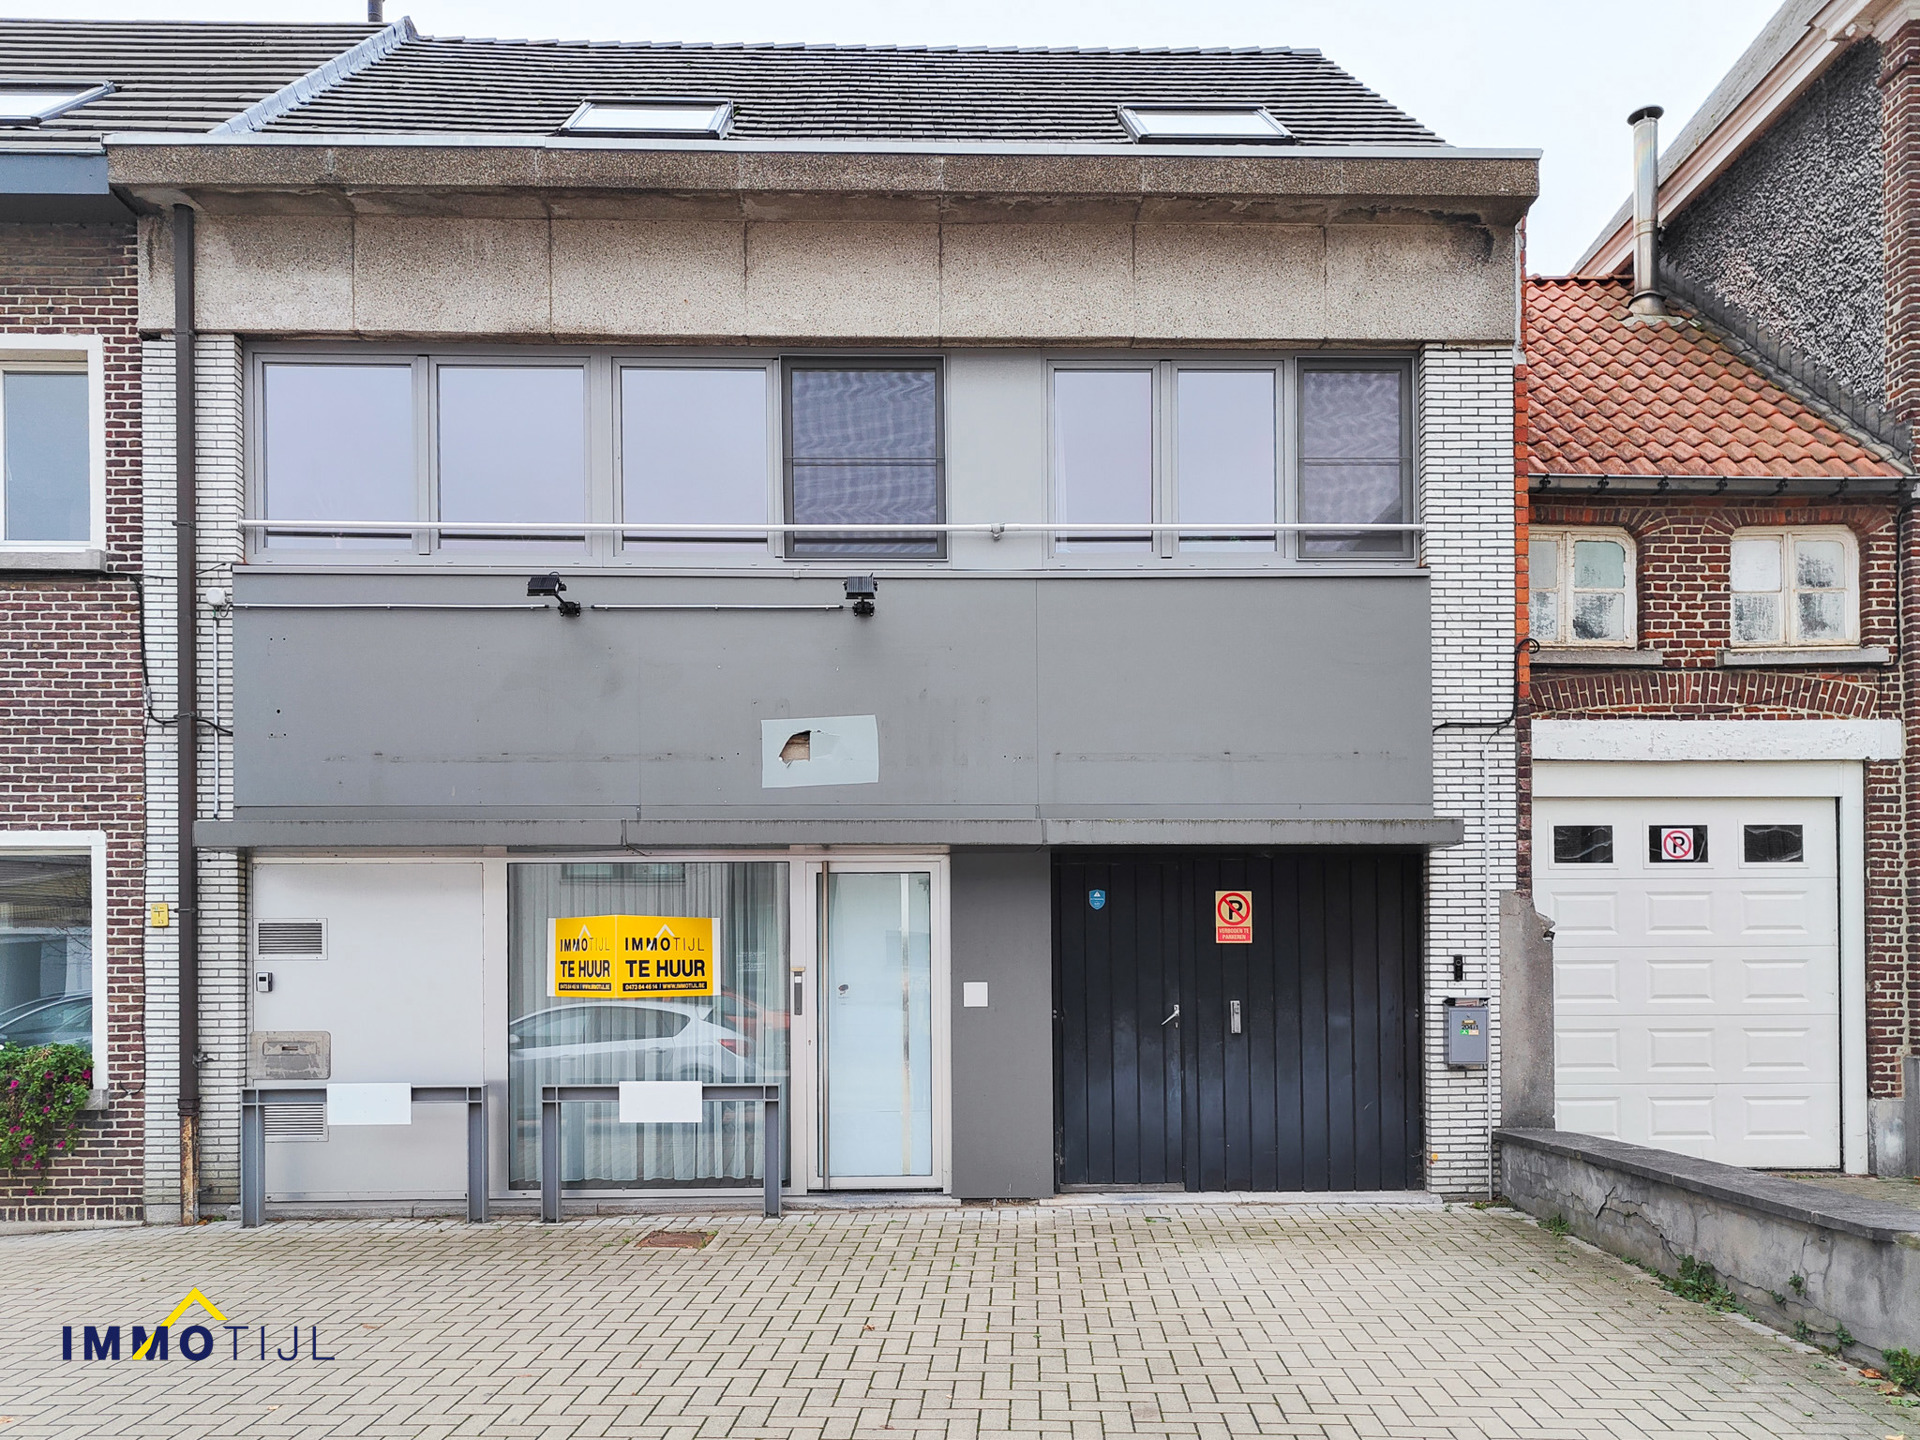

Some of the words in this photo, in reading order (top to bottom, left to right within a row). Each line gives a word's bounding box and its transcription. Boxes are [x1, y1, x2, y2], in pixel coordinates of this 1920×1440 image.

[560, 937, 610, 952] IMMOTIJL
[625, 937, 704, 951] IMMOTIJL
[560, 960, 575, 978] TE
[579, 960, 611, 978] HUUR
[625, 960, 650, 978] TE
[657, 959, 705, 977] HUUR
